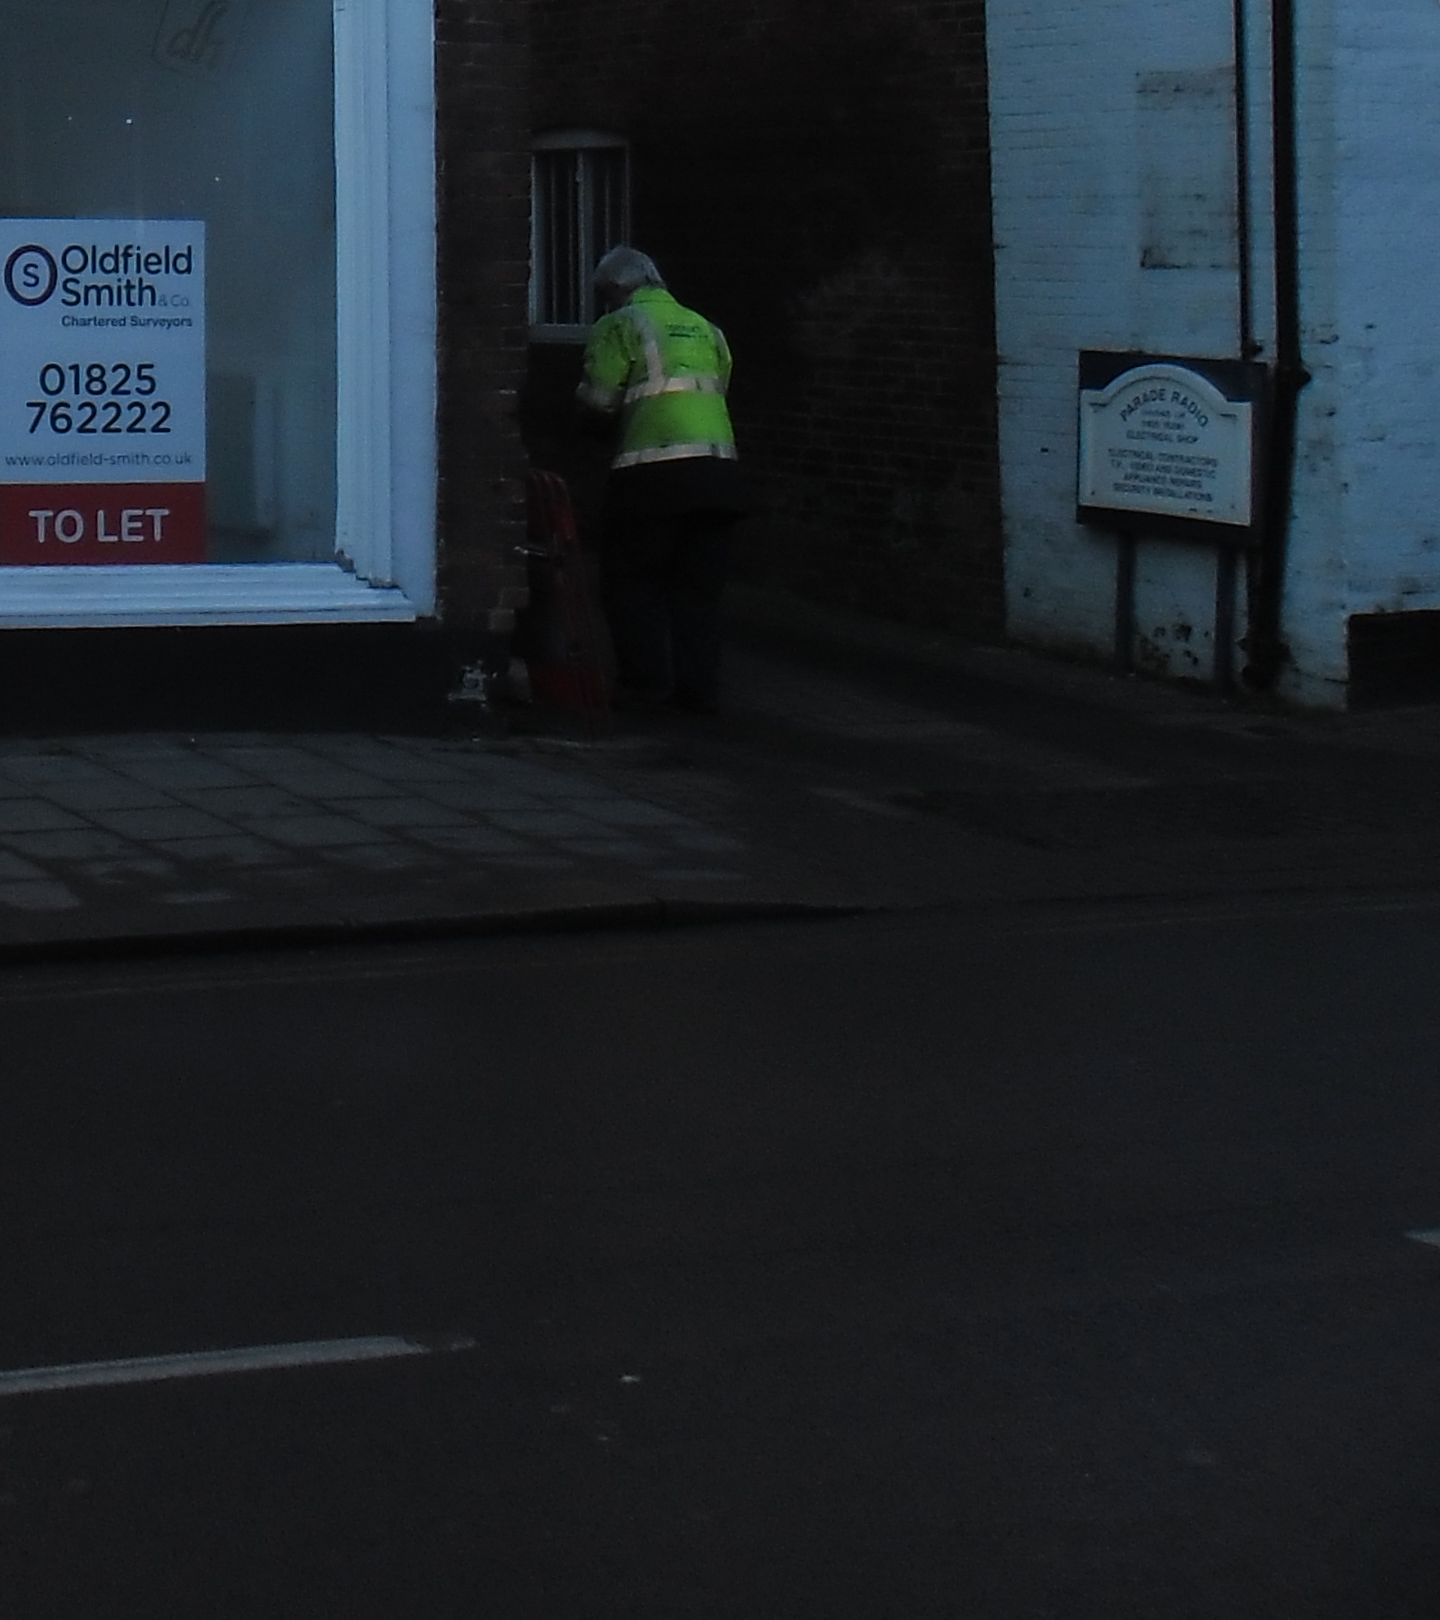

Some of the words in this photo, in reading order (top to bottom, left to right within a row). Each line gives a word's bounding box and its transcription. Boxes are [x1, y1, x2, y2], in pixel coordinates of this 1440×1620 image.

[61, 244, 193, 275] Oldfield
[61, 278, 157, 307] Smith
[159, 294, 168, 307] &
[61, 315, 126, 327] Chartered
[129, 315, 193, 330] Surveyors
[39, 363, 157, 396] 01825
[25, 401, 172, 434] 762222
[1120, 388, 1166, 422] PARADE
[1170, 390, 1209, 428] RADIO
[5, 452, 192, 467] www.oldfield-smith.co.uk
[28, 509, 85, 543] TO
[96, 509, 170, 543] LET
